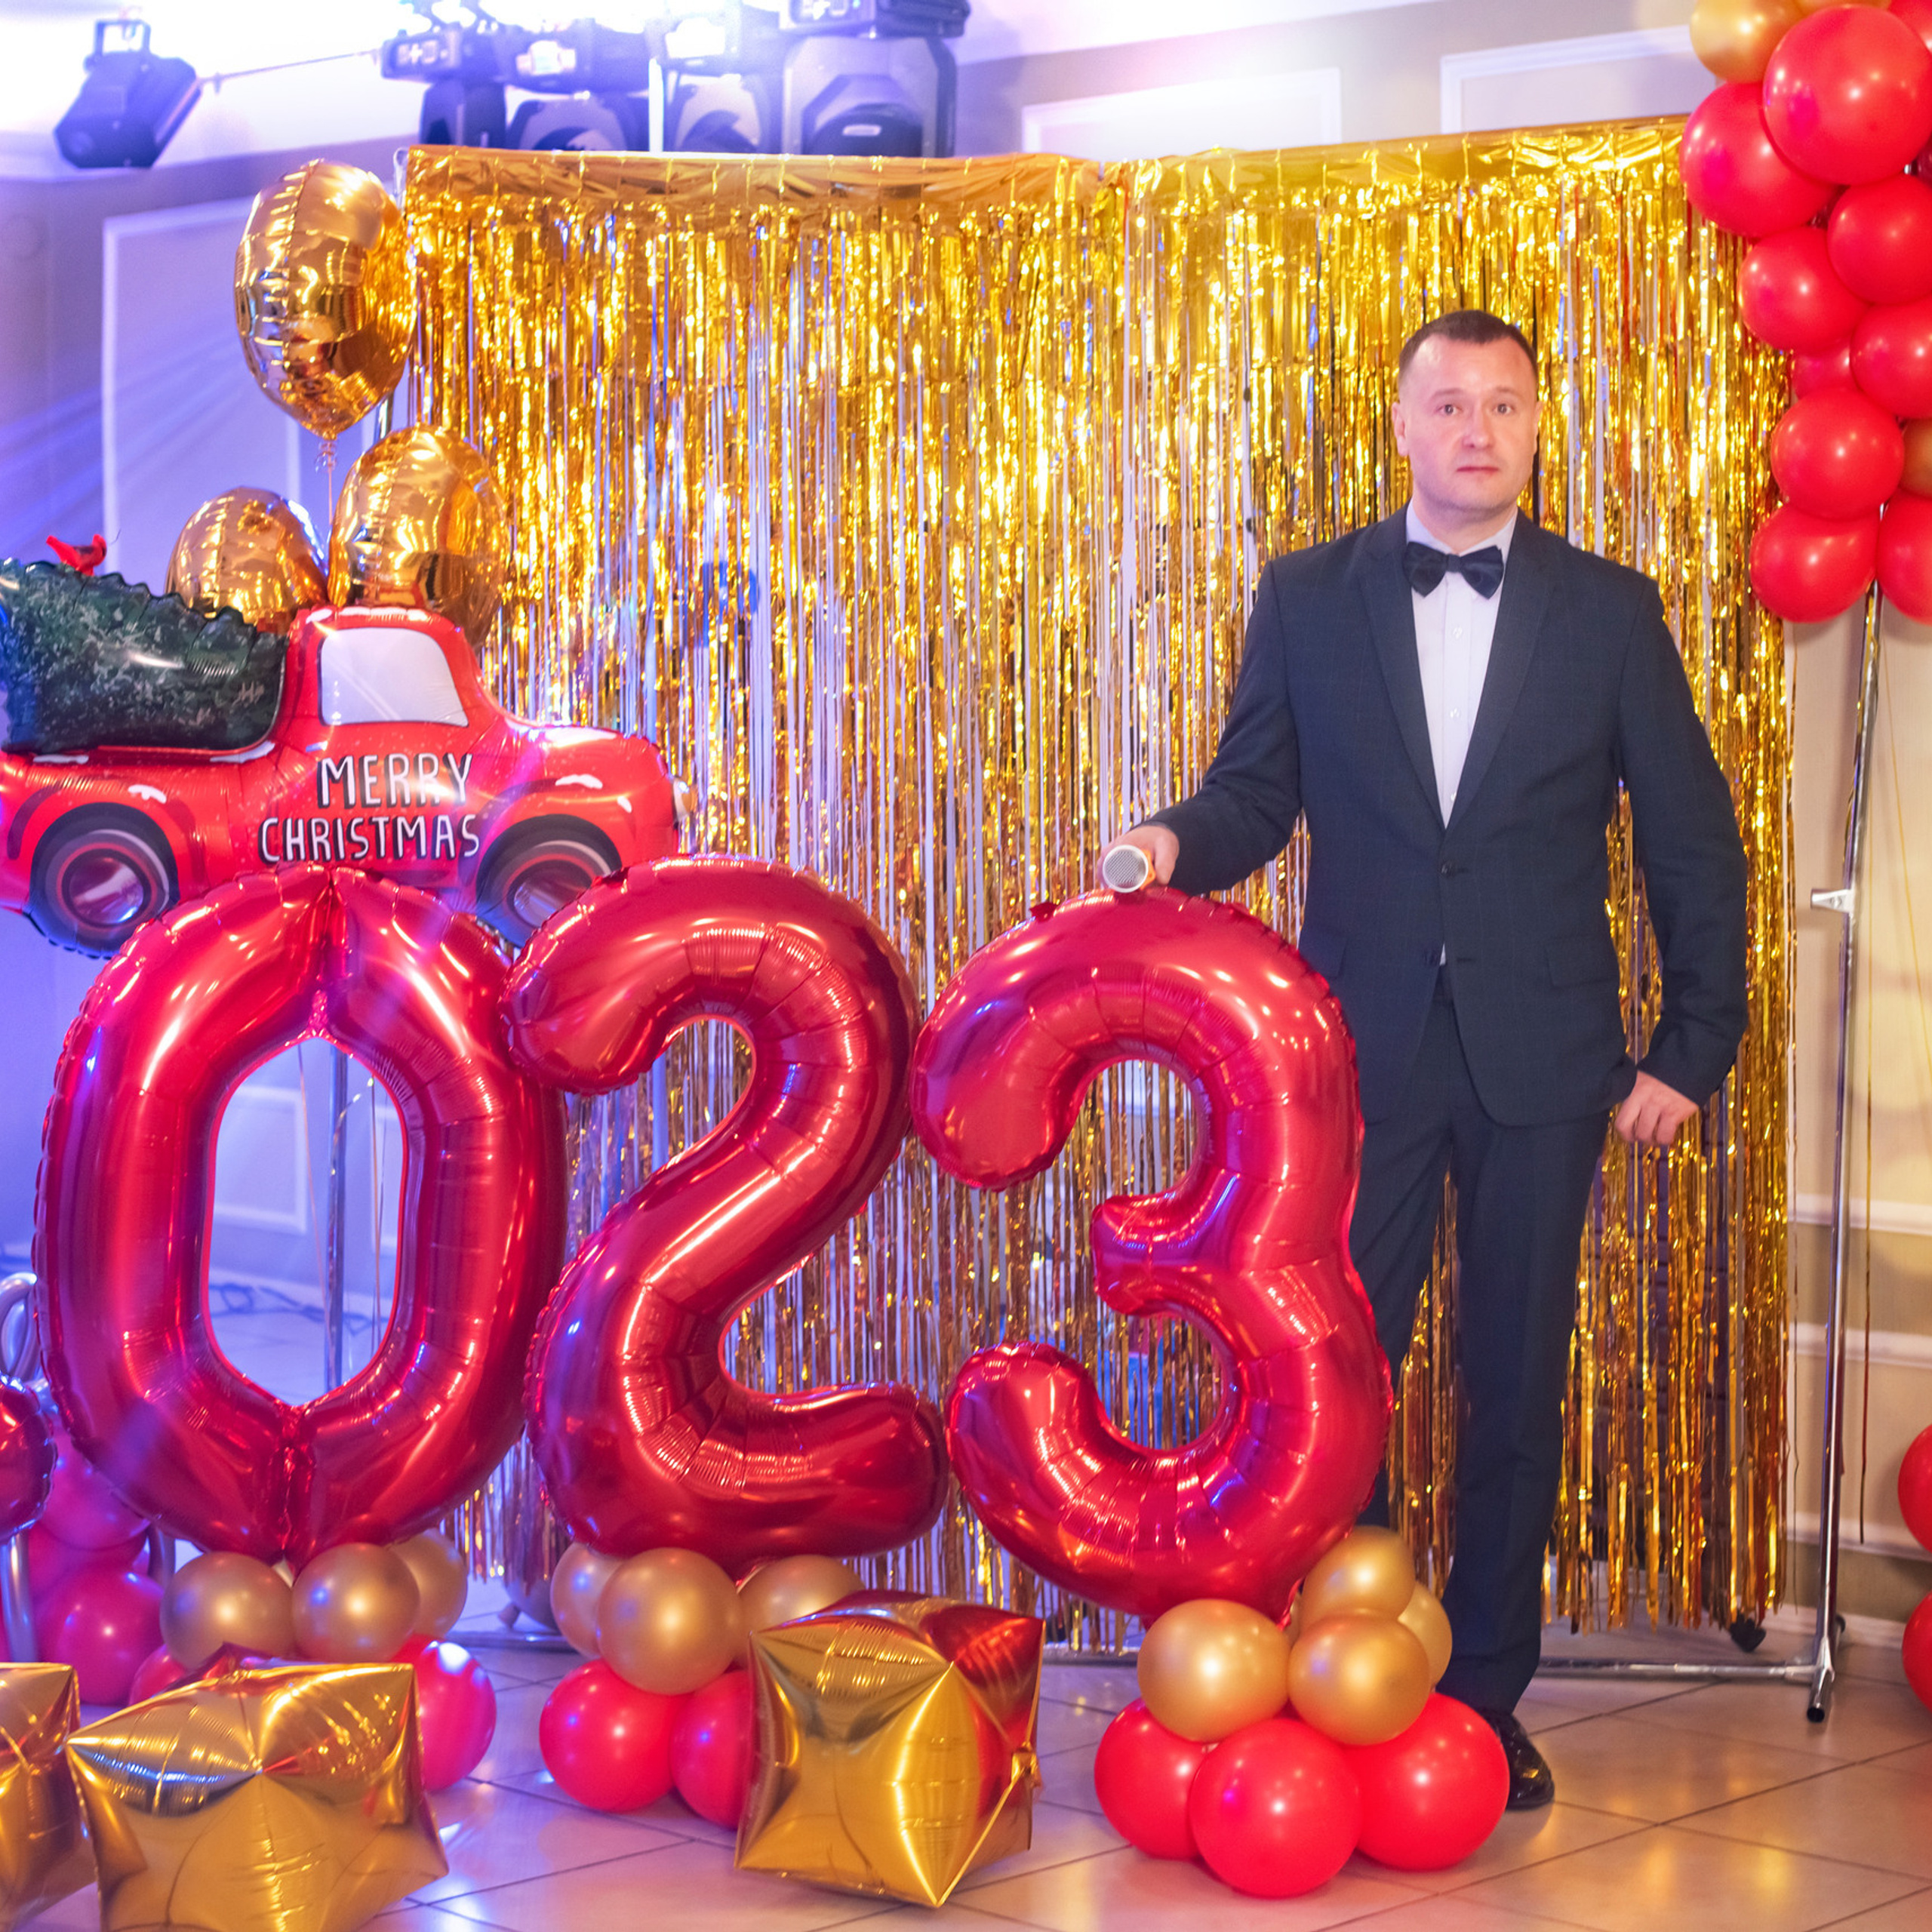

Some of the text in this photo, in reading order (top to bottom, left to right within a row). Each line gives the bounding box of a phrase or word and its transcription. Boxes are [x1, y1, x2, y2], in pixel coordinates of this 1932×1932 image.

[317, 753, 472, 808] MERRY
[258, 814, 479, 863] CHRISTMAS
[0, 857, 1394, 1629] 023
